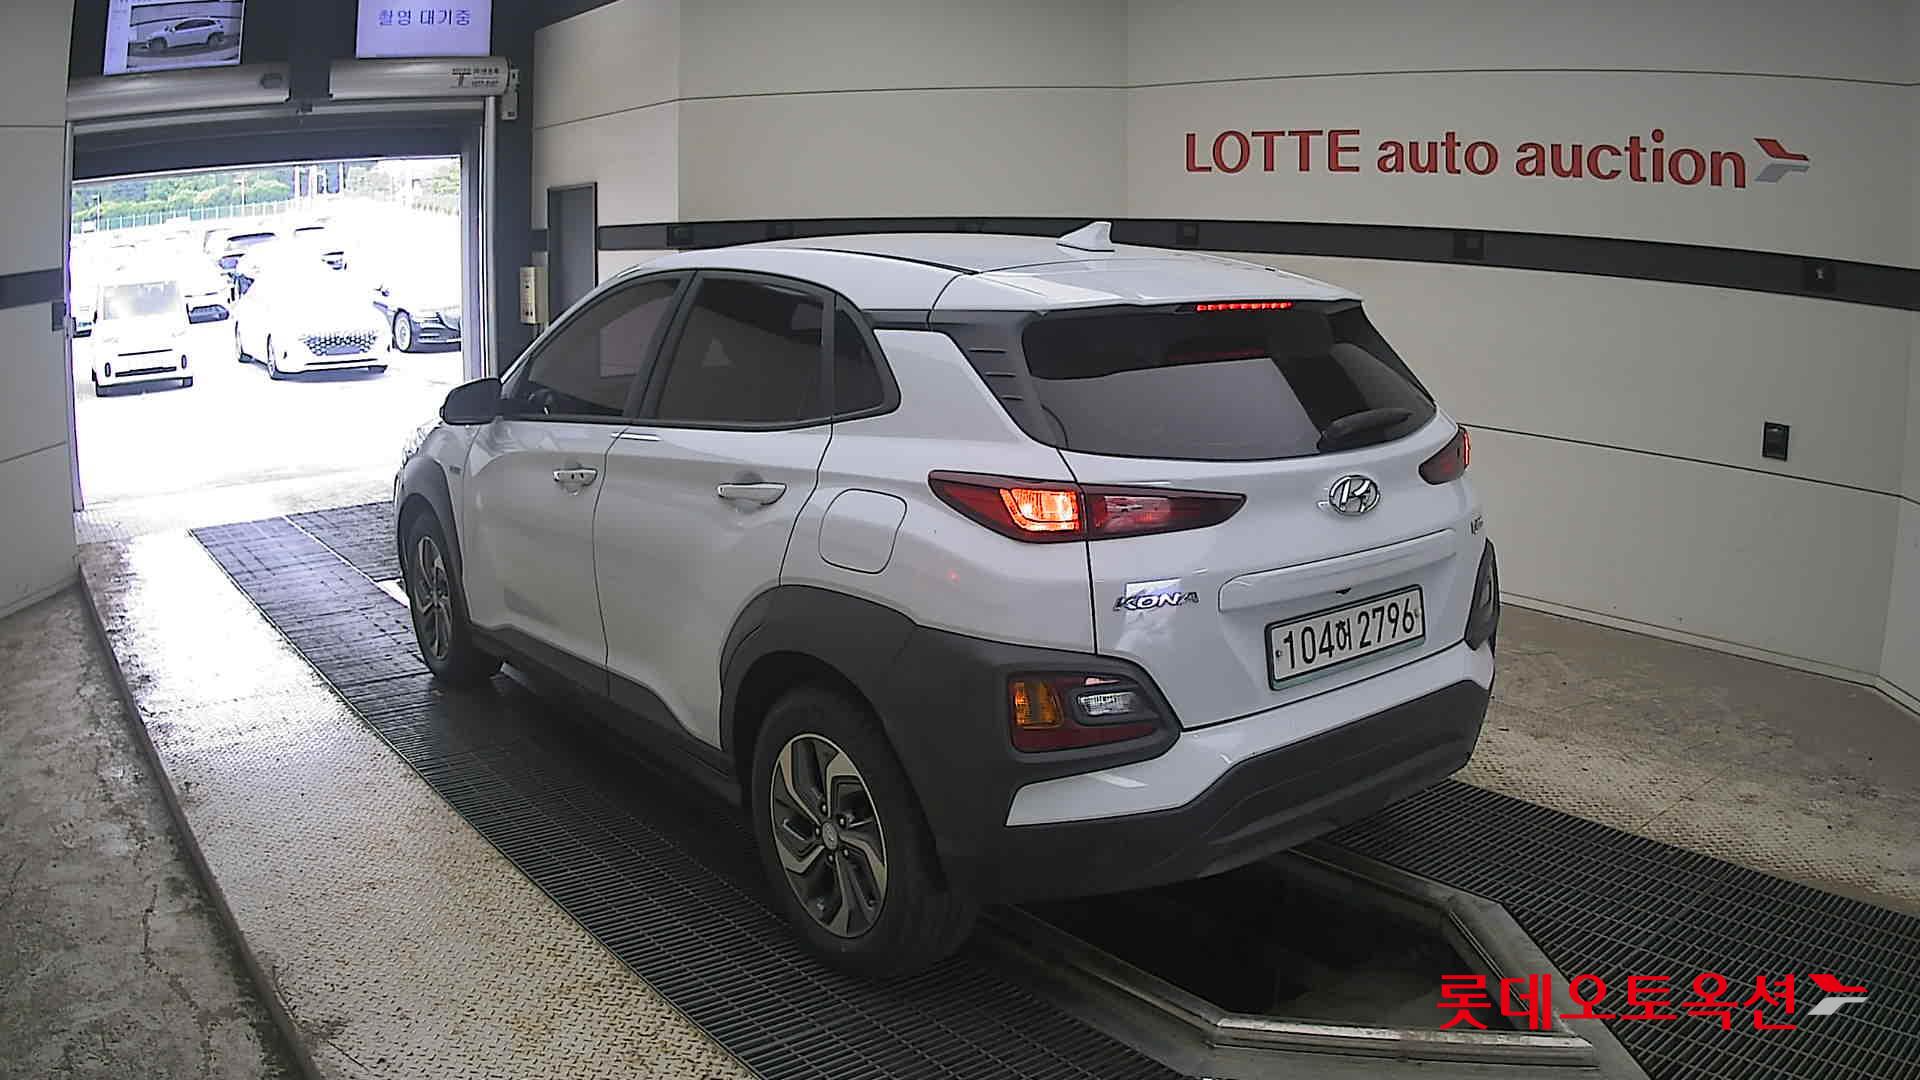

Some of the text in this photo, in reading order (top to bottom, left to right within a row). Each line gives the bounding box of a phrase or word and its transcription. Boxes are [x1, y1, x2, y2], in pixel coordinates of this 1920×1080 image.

[378, 8, 472, 26] 촬영 대기중
[1185, 128, 1747, 189] LOTTE auto auction
[1113, 588, 1200, 612] KONA
